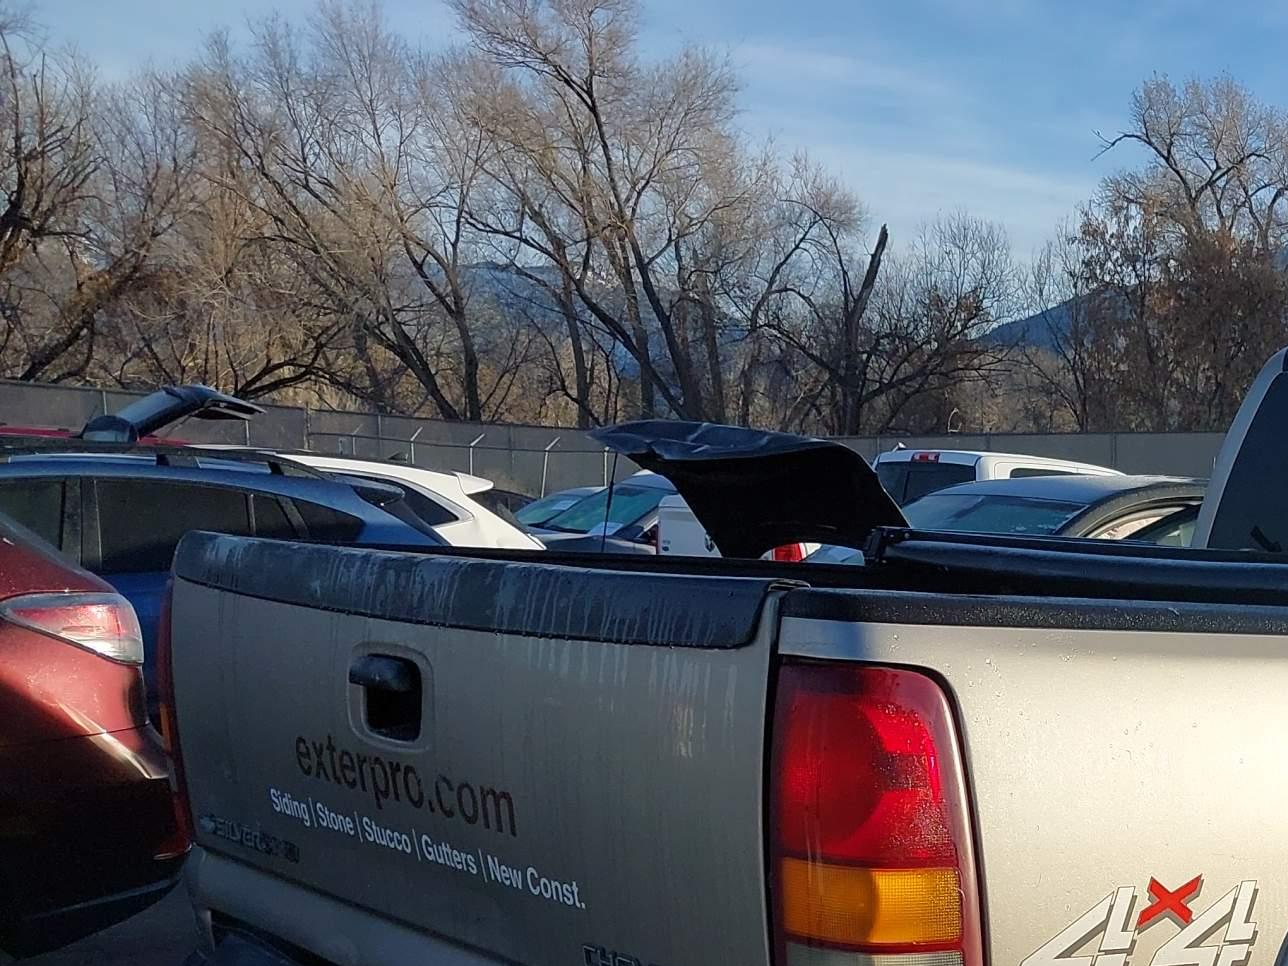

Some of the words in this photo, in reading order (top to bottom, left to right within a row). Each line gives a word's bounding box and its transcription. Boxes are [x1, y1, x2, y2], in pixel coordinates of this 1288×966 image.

[295, 735, 517, 837] exterpro.com
[270, 788, 312, 827] Siding
[316, 803, 355, 836] Stone
[362, 817, 412, 853] Stucco
[421, 834, 478, 875] Gutters
[487, 854, 523, 890] New
[526, 866, 586, 910] Const.
